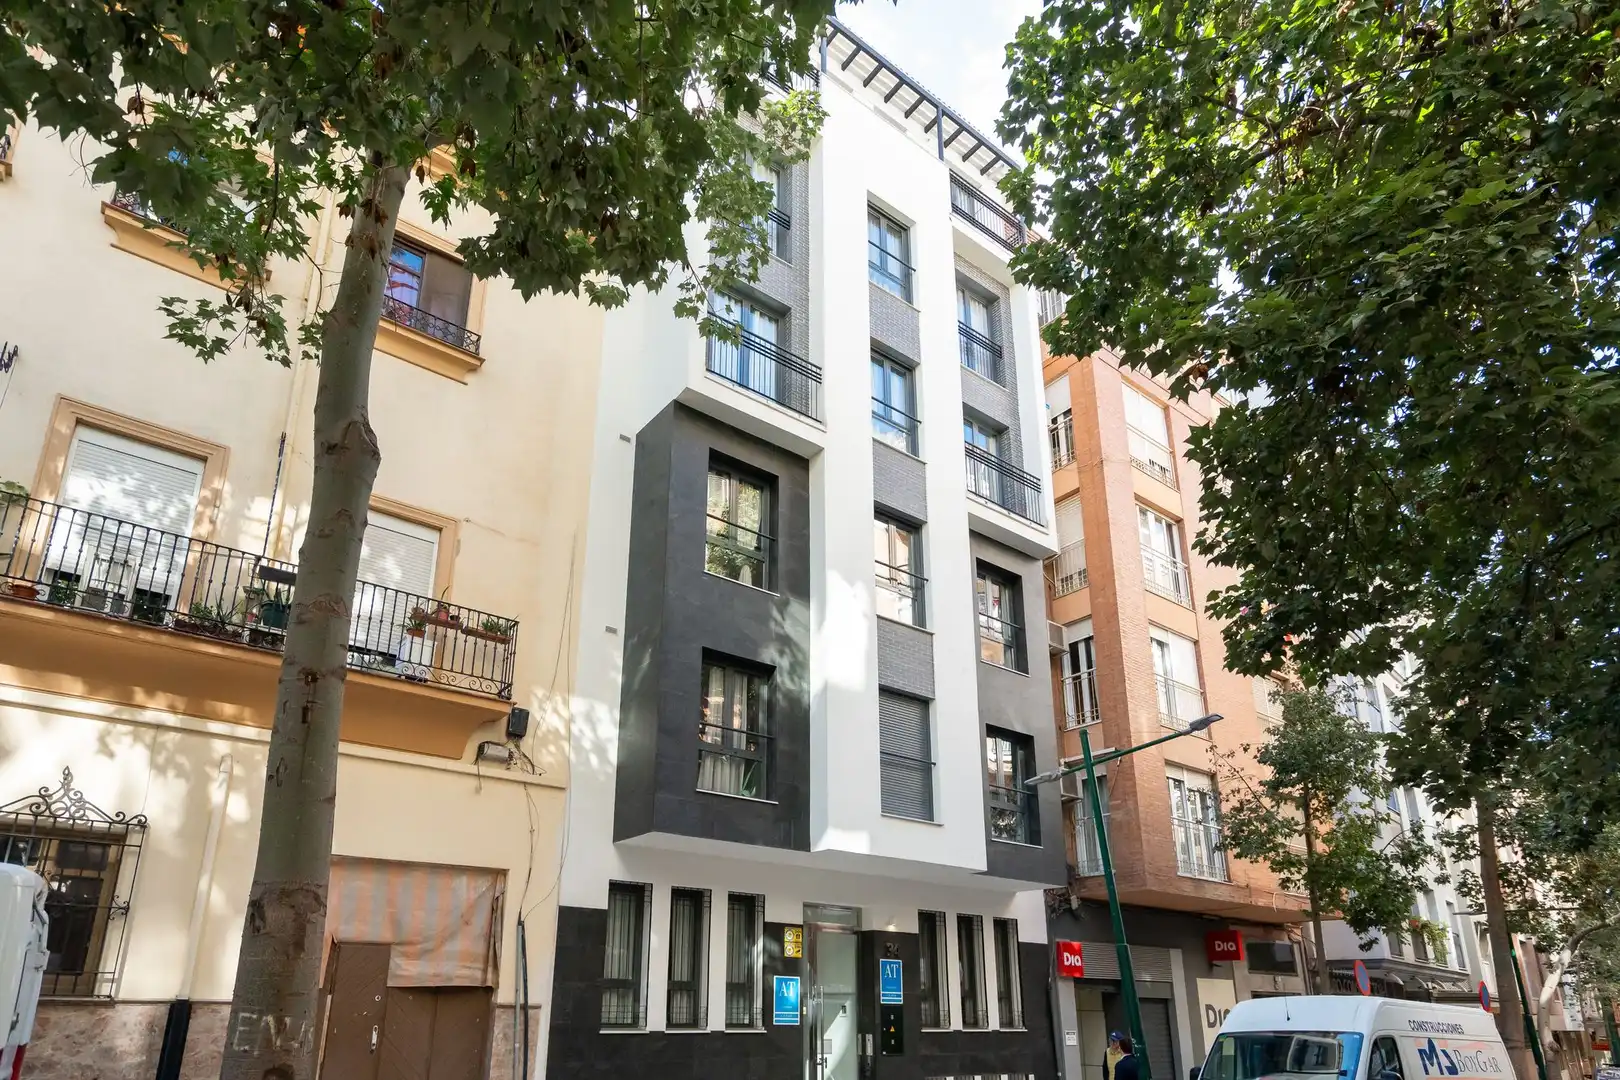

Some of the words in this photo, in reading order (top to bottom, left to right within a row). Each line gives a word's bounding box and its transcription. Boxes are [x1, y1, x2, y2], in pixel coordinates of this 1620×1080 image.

[884, 963, 899, 978] AT
[779, 981, 796, 997] AT
[1408, 1019, 1465, 1035] CONSTRUCCIONES
